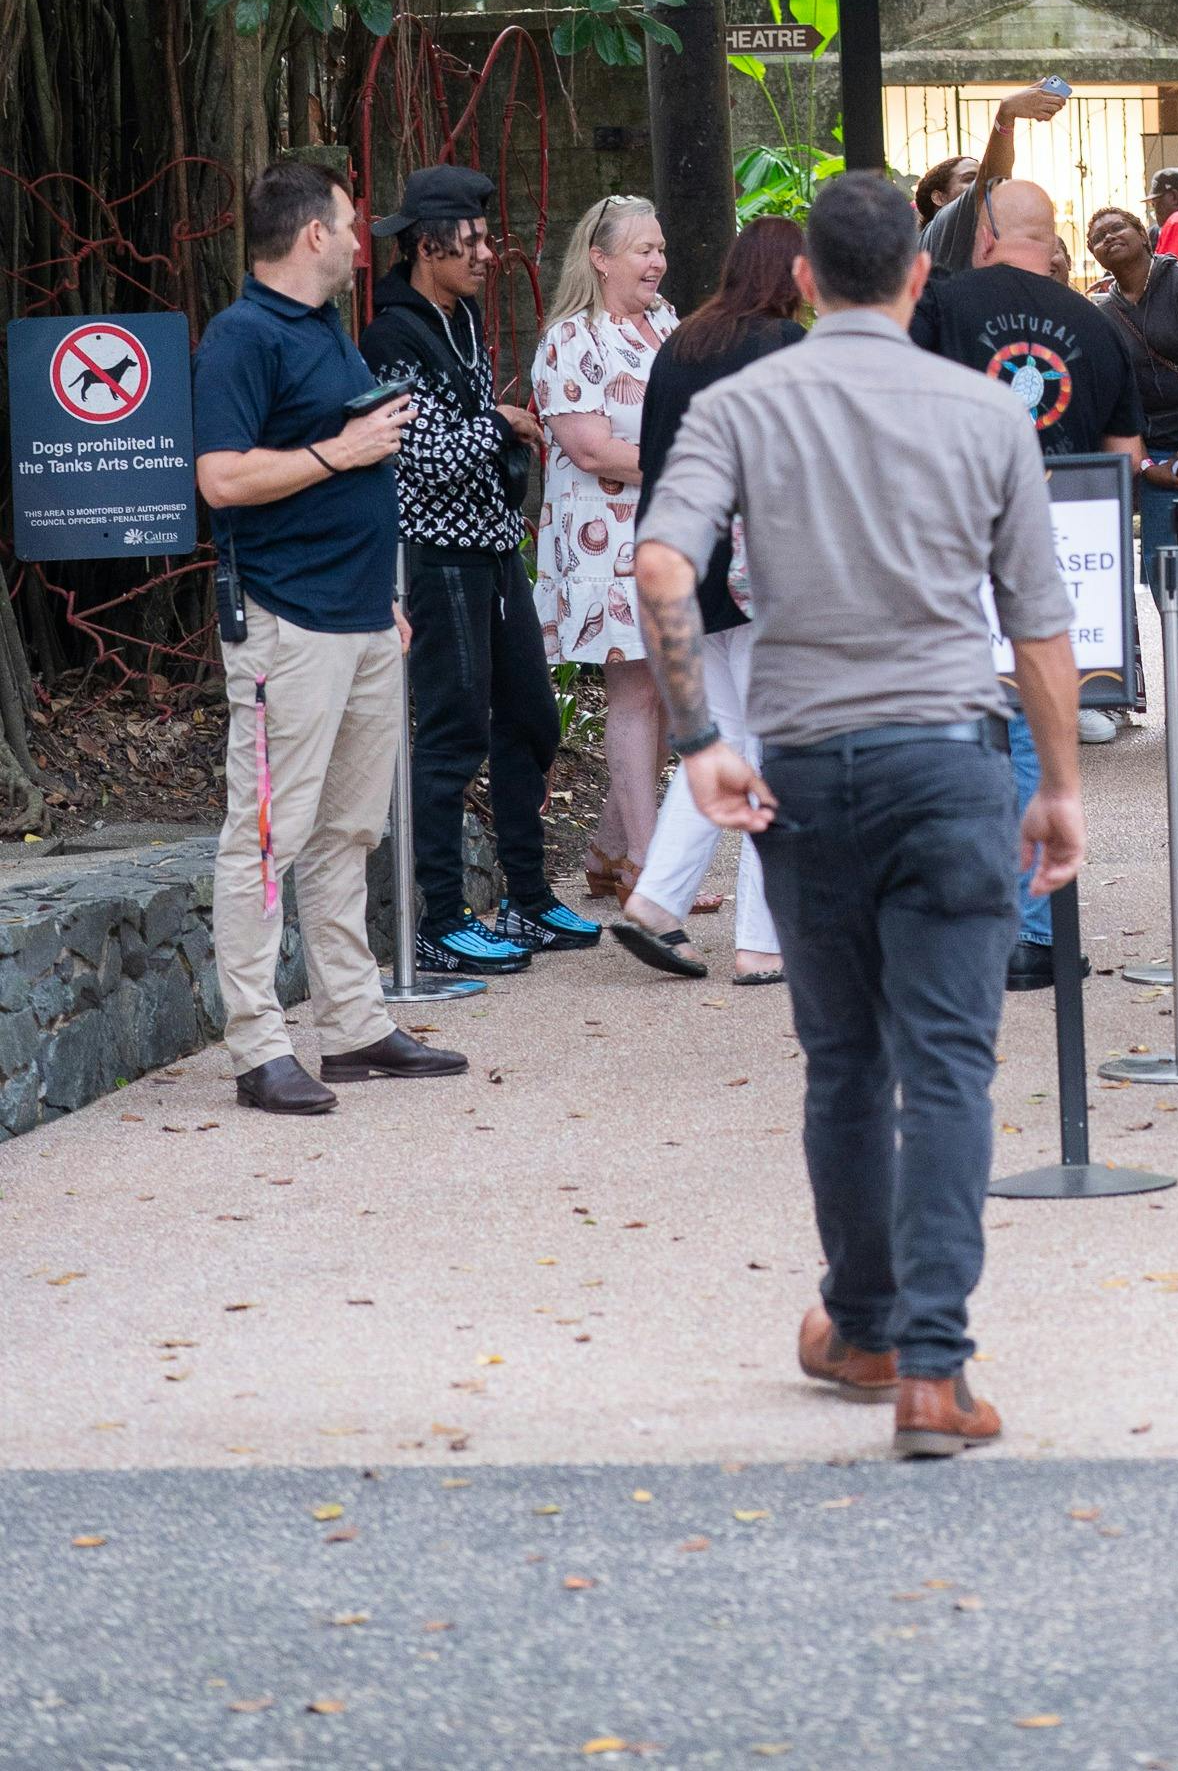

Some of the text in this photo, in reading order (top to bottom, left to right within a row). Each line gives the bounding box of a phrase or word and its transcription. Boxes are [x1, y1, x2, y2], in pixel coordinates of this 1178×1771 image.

[985, 313, 1077, 348] CULTURAL
[32, 436, 175, 457] Dogs prohibited in
[18, 455, 189, 475] the Tanks Arts Centre.
[24, 503, 187, 518] THIS AREA IS MONITORED BY AUTHORISED
[30, 518, 67, 527] COUNCIL
[68, 516, 108, 526] OFFICERS
[113, 514, 155, 524] PENALTIES
[156, 512, 181, 521] APPLY.
[143, 530, 179, 542] Cairns
